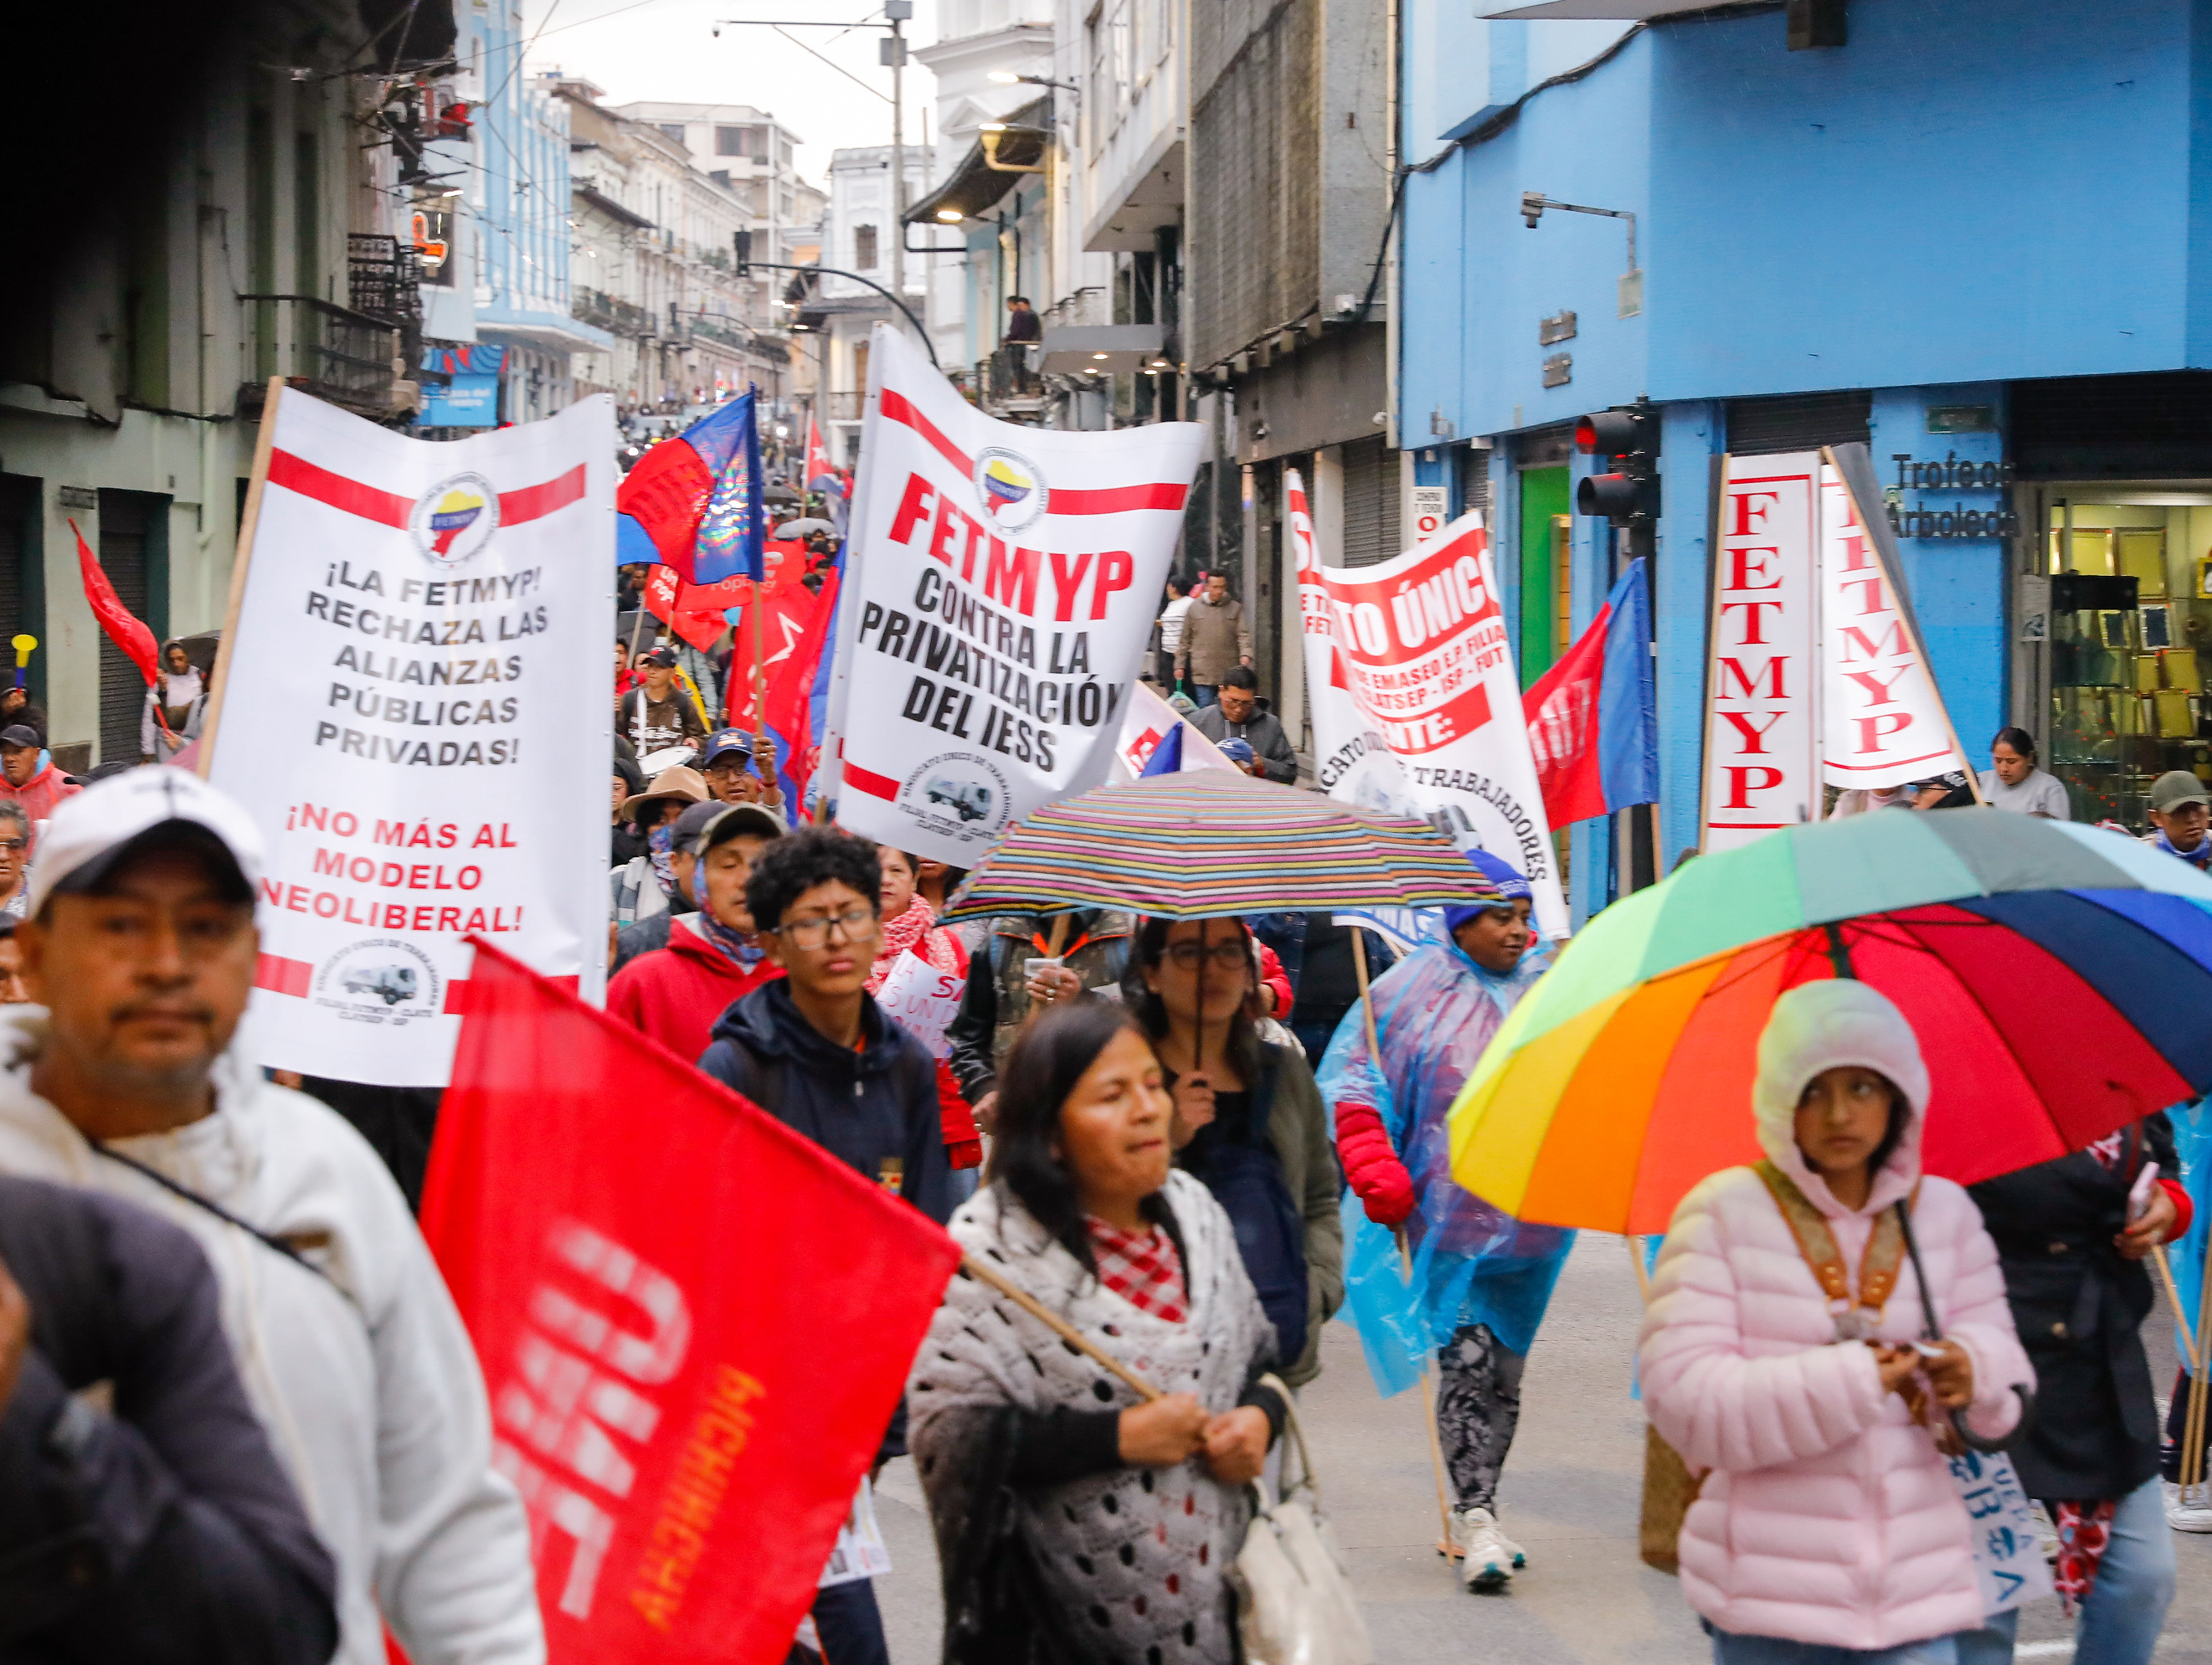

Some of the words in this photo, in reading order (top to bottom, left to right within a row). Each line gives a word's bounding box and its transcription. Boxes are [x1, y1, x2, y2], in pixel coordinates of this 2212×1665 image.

[888, 471, 1134, 622] FETMYP
[326, 561, 384, 598] ¡LA
[399, 567, 541, 606] FETMYP!
[306, 591, 485, 645] RECHAZA
[499, 606, 548, 640] LAS
[914, 567, 1036, 670] CONTRA
[1048, 630, 1089, 675] LA
[334, 645, 522, 686] ALIANZAS
[1475, 646, 1504, 673] FUT
[1715, 491, 1791, 809] FETMYP
[328, 676, 518, 727] PÚBLICAS
[902, 675, 975, 739] DEL
[980, 701, 1059, 772] IESS
[315, 722, 519, 767] PRIVADAS!
[286, 802, 358, 837] ¡NO
[373, 817, 457, 849] MÁS
[473, 823, 517, 848] AL
[1414, 767, 1546, 881] TRABAJADORES
[313, 848, 483, 890] MODELO
[257, 877, 522, 933] NEOLIBERAL!
